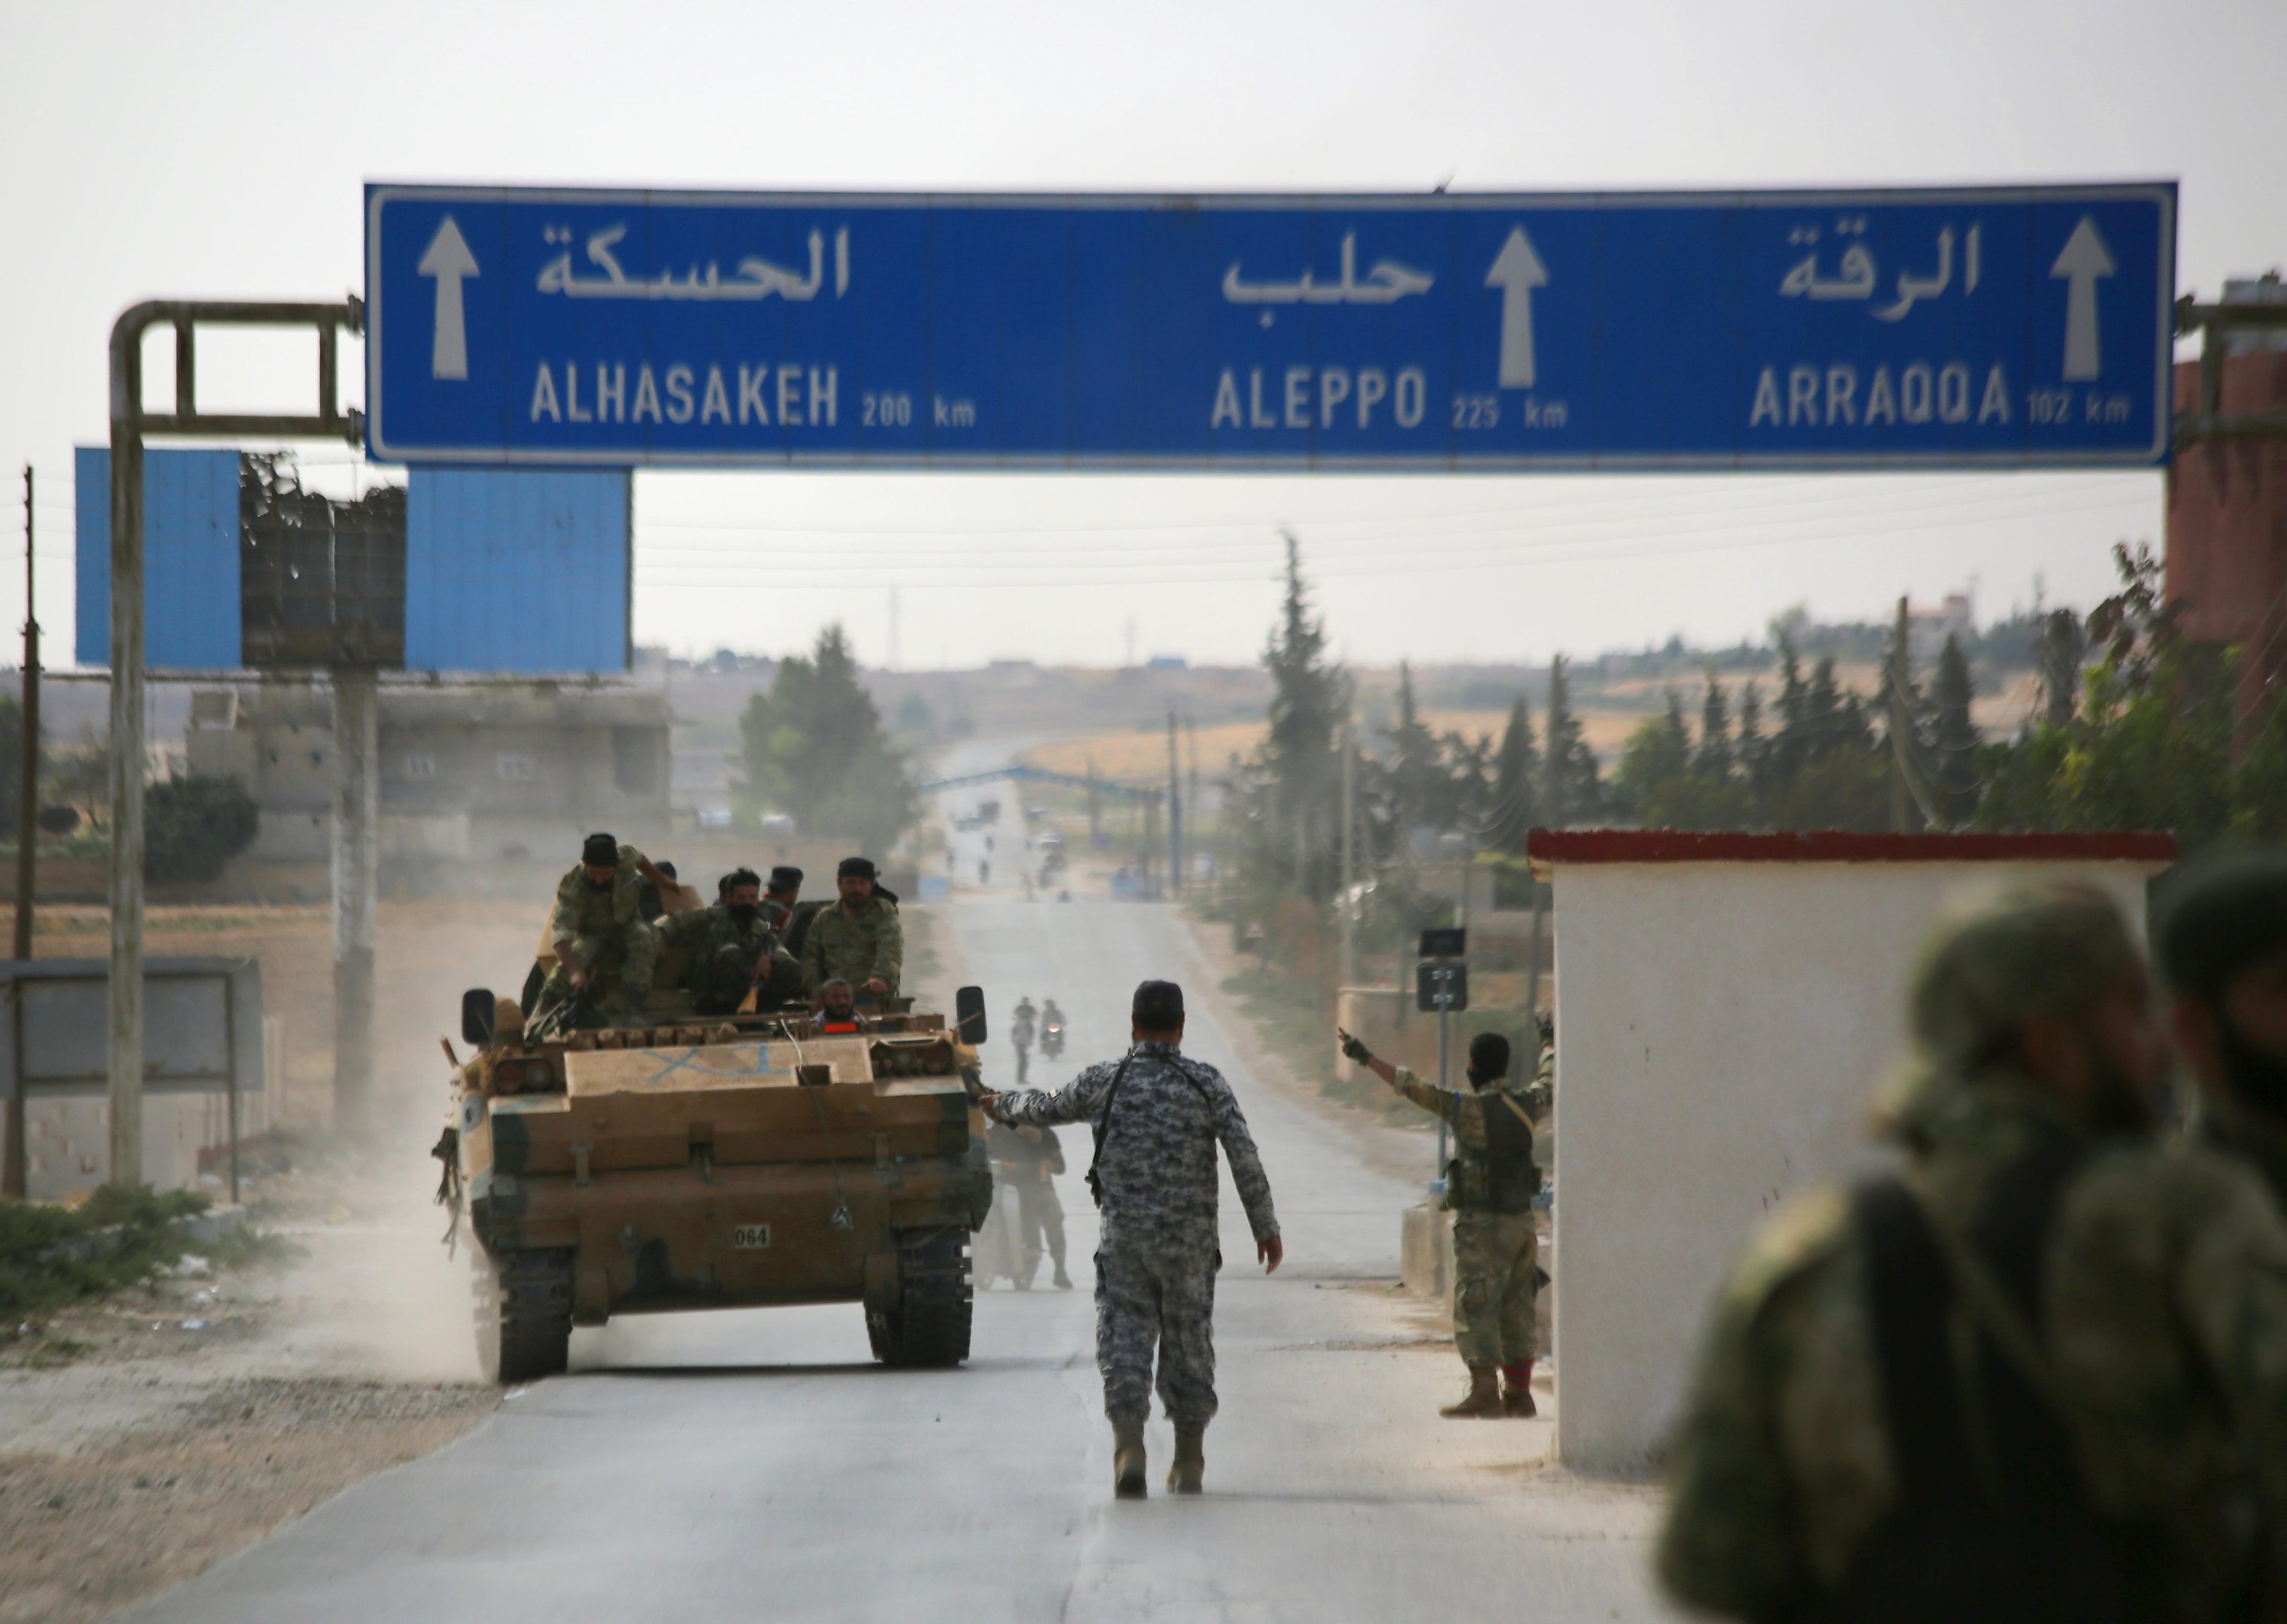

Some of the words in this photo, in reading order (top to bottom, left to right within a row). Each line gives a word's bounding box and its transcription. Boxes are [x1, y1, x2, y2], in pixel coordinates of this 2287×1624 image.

[536, 225, 850, 301] الحسكة
[1221, 232, 1434, 329] حلب
[1779, 219, 1980, 322] الرقة
[530, 362, 838, 426] ALHASAKEH
[861, 392, 913, 428] 200
[934, 395, 976, 427] km
[1210, 368, 1425, 429] ALEPPO
[1452, 395, 1498, 428] 225
[1524, 398, 1567, 427] km
[1749, 364, 2009, 426] ARRAQQA
[2027, 390, 2070, 423] 102
[2086, 391, 2131, 422] km
[736, 1228, 767, 1246] 064
